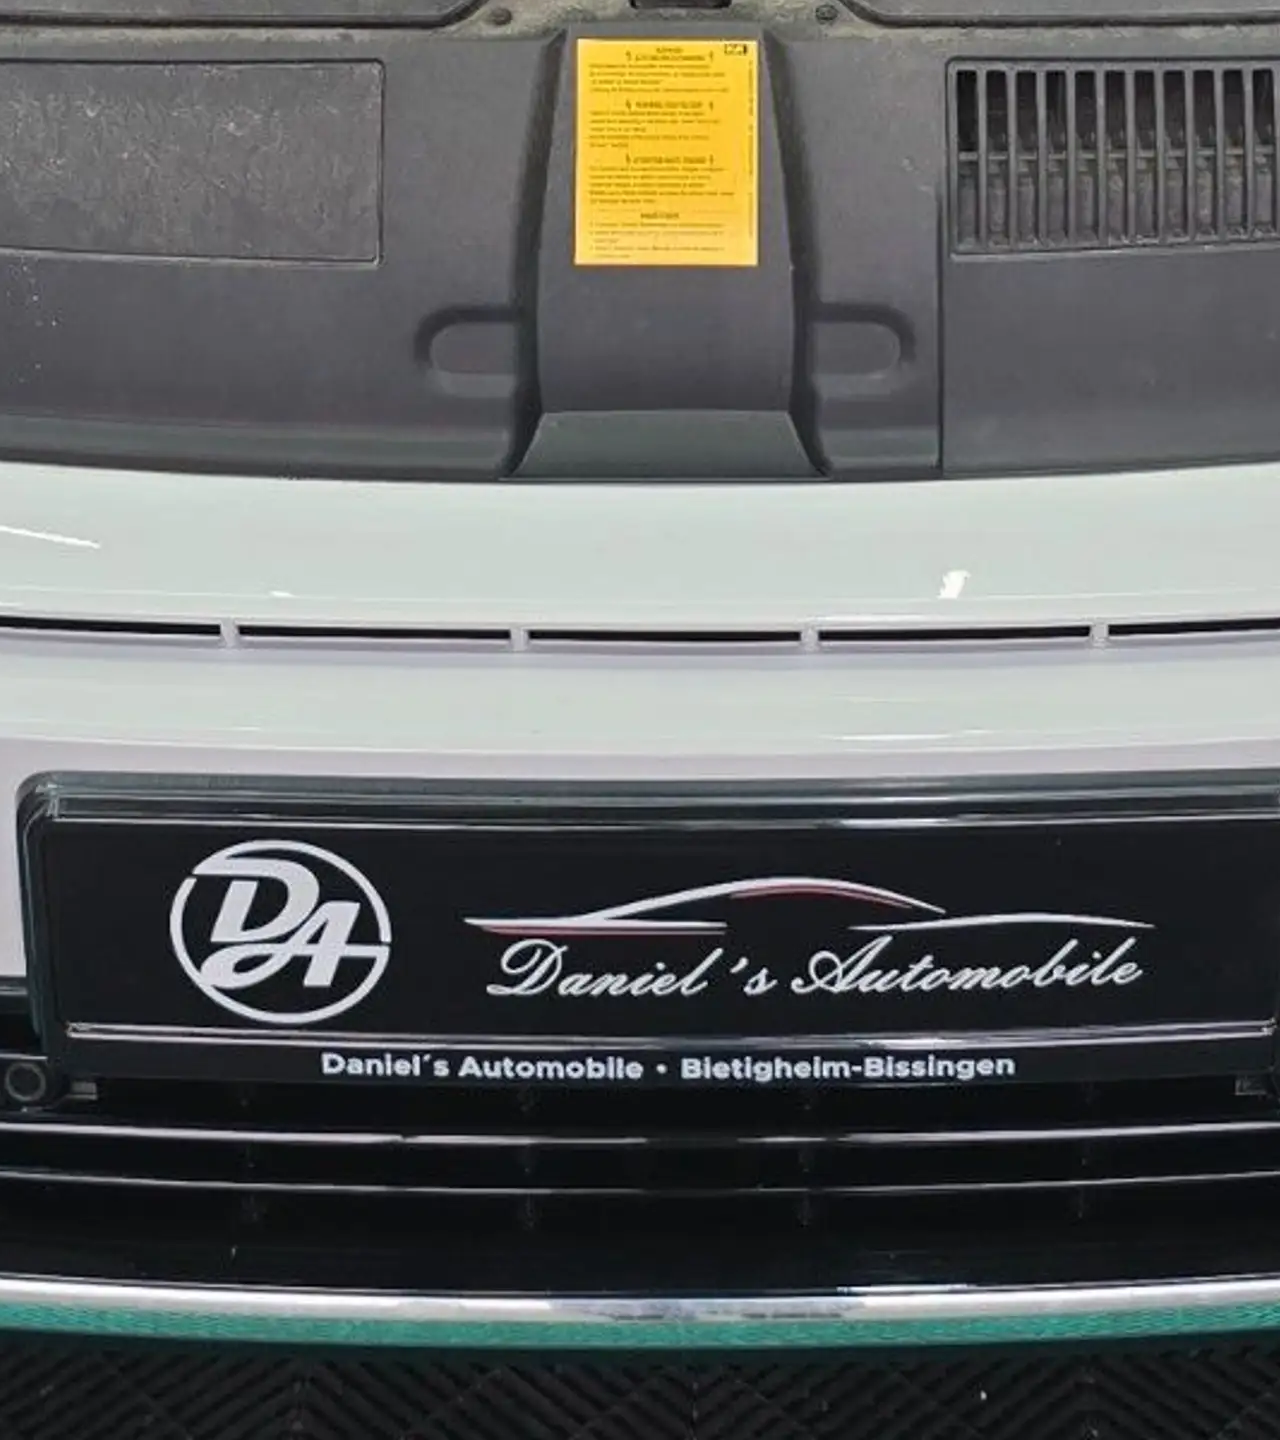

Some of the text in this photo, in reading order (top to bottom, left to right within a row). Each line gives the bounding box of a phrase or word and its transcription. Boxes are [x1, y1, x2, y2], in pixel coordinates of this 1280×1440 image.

[790, 934, 1144, 994] Automobile
[457, 1055, 645, 1080] Automobile
[680, 1054, 1016, 1082] Bietigheim-Bissingen
